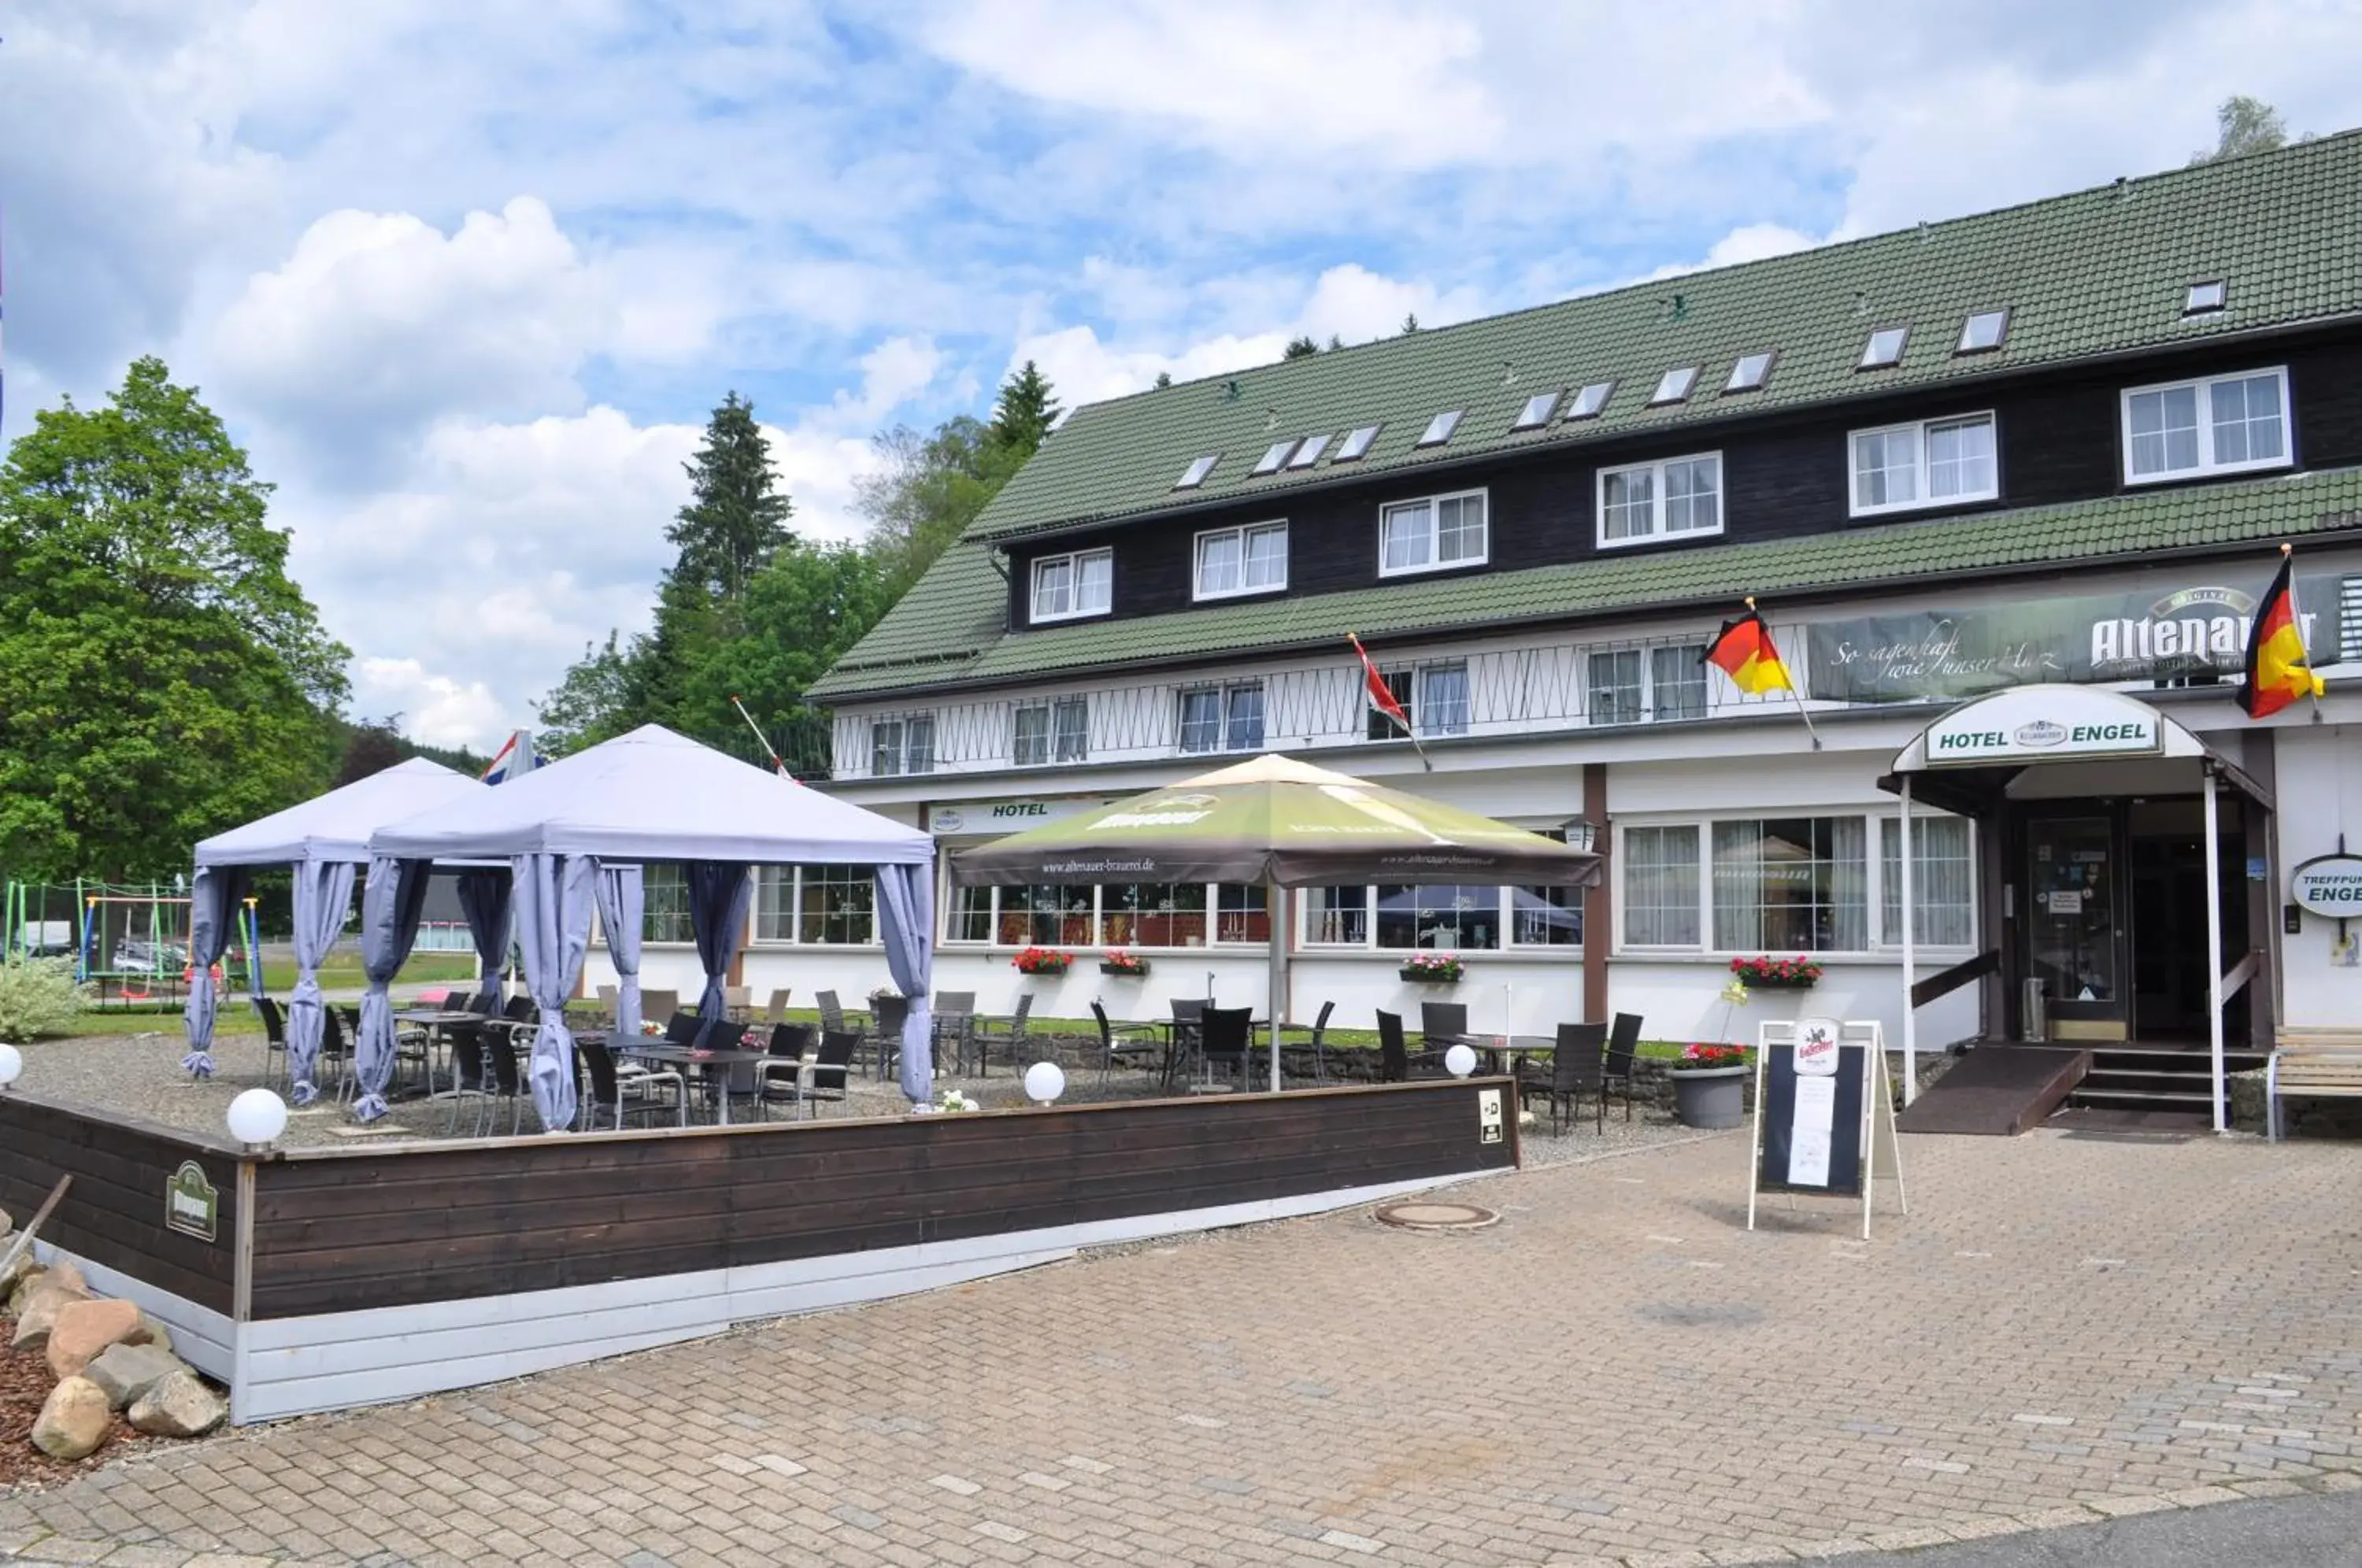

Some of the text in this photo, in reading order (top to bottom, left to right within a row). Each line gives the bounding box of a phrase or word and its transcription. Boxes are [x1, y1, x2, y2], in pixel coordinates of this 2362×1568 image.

[2091, 612, 2317, 668] Altenar
[1831, 642, 1860, 665] So
[1939, 732, 2008, 749] HOTEL
[2071, 723, 2146, 742] ENGEL
[993, 803, 1048, 817] HOTEL
[2308, 888, 2362, 901] ENGE
